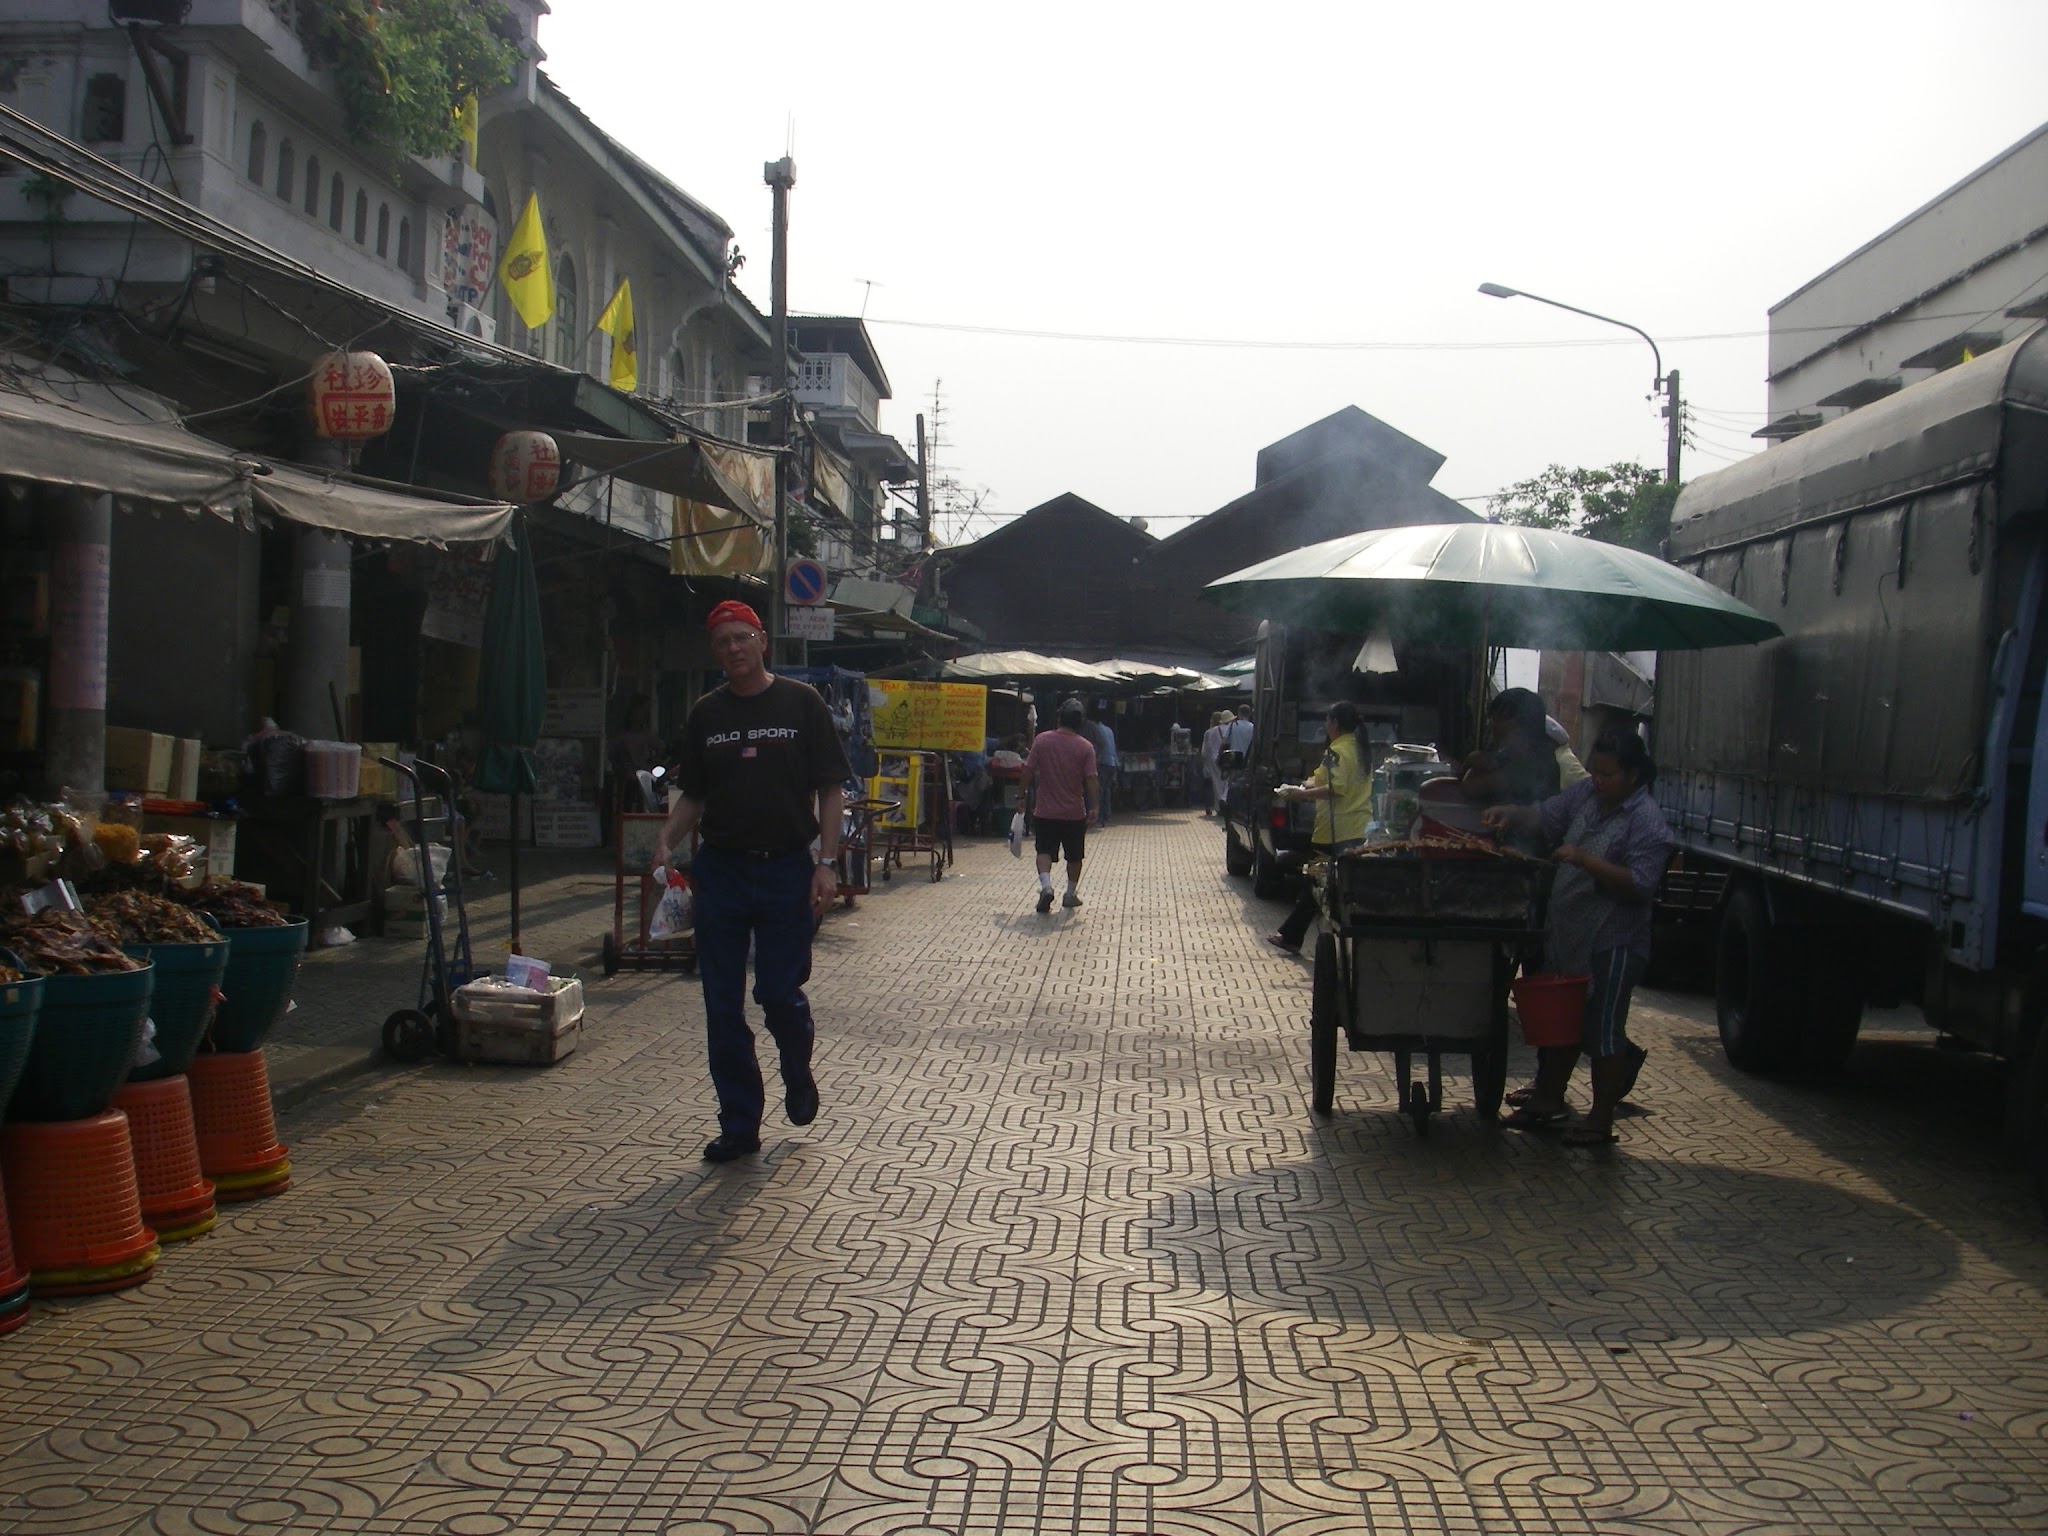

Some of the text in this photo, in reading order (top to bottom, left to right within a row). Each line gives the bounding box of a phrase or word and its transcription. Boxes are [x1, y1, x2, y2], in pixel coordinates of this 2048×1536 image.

[879, 681, 899, 692] THAI
[706, 728, 798, 747] POLO SPORT
